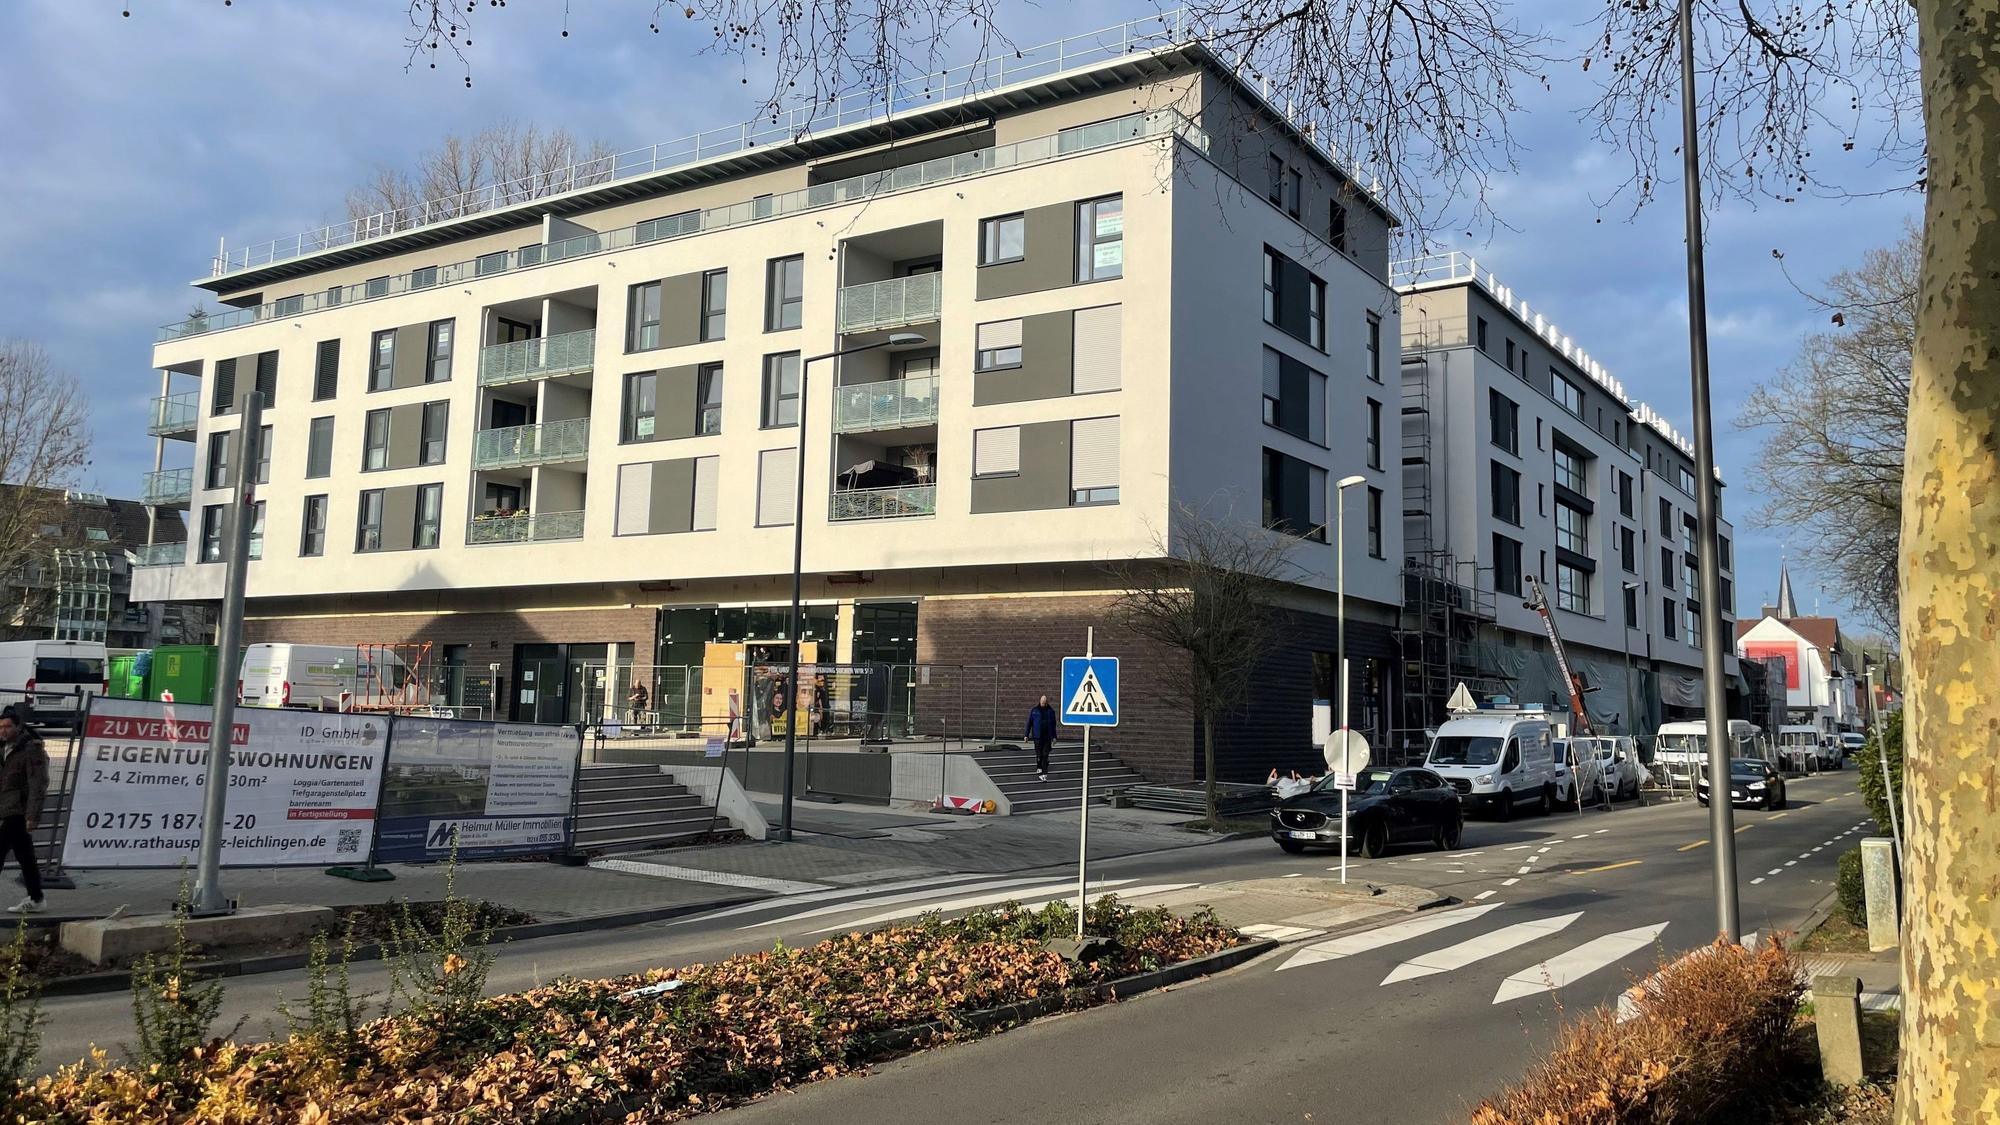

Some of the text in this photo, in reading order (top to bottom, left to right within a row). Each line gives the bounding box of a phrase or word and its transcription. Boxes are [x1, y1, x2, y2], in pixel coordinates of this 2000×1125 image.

[103, 720, 245, 741] ZU VERKAUN
[301, 726, 360, 740] ID GmbH
[93, 769, 121, 783] 2-4
[126, 771, 189, 787] Zimmer,
[293, 778, 365, 788] Loggia/Gartenanteil
[291, 788, 367, 798] Tiefgaragenstellplatz
[289, 800, 332, 808] barrierearm
[86, 812, 153, 830] 02175
[298, 810, 348, 820] Fertigstellung
[461, 819, 562, 832] Helmut Müller Immobilien
[83, 835, 327, 851] www.rathauspz-leichlingen.de
